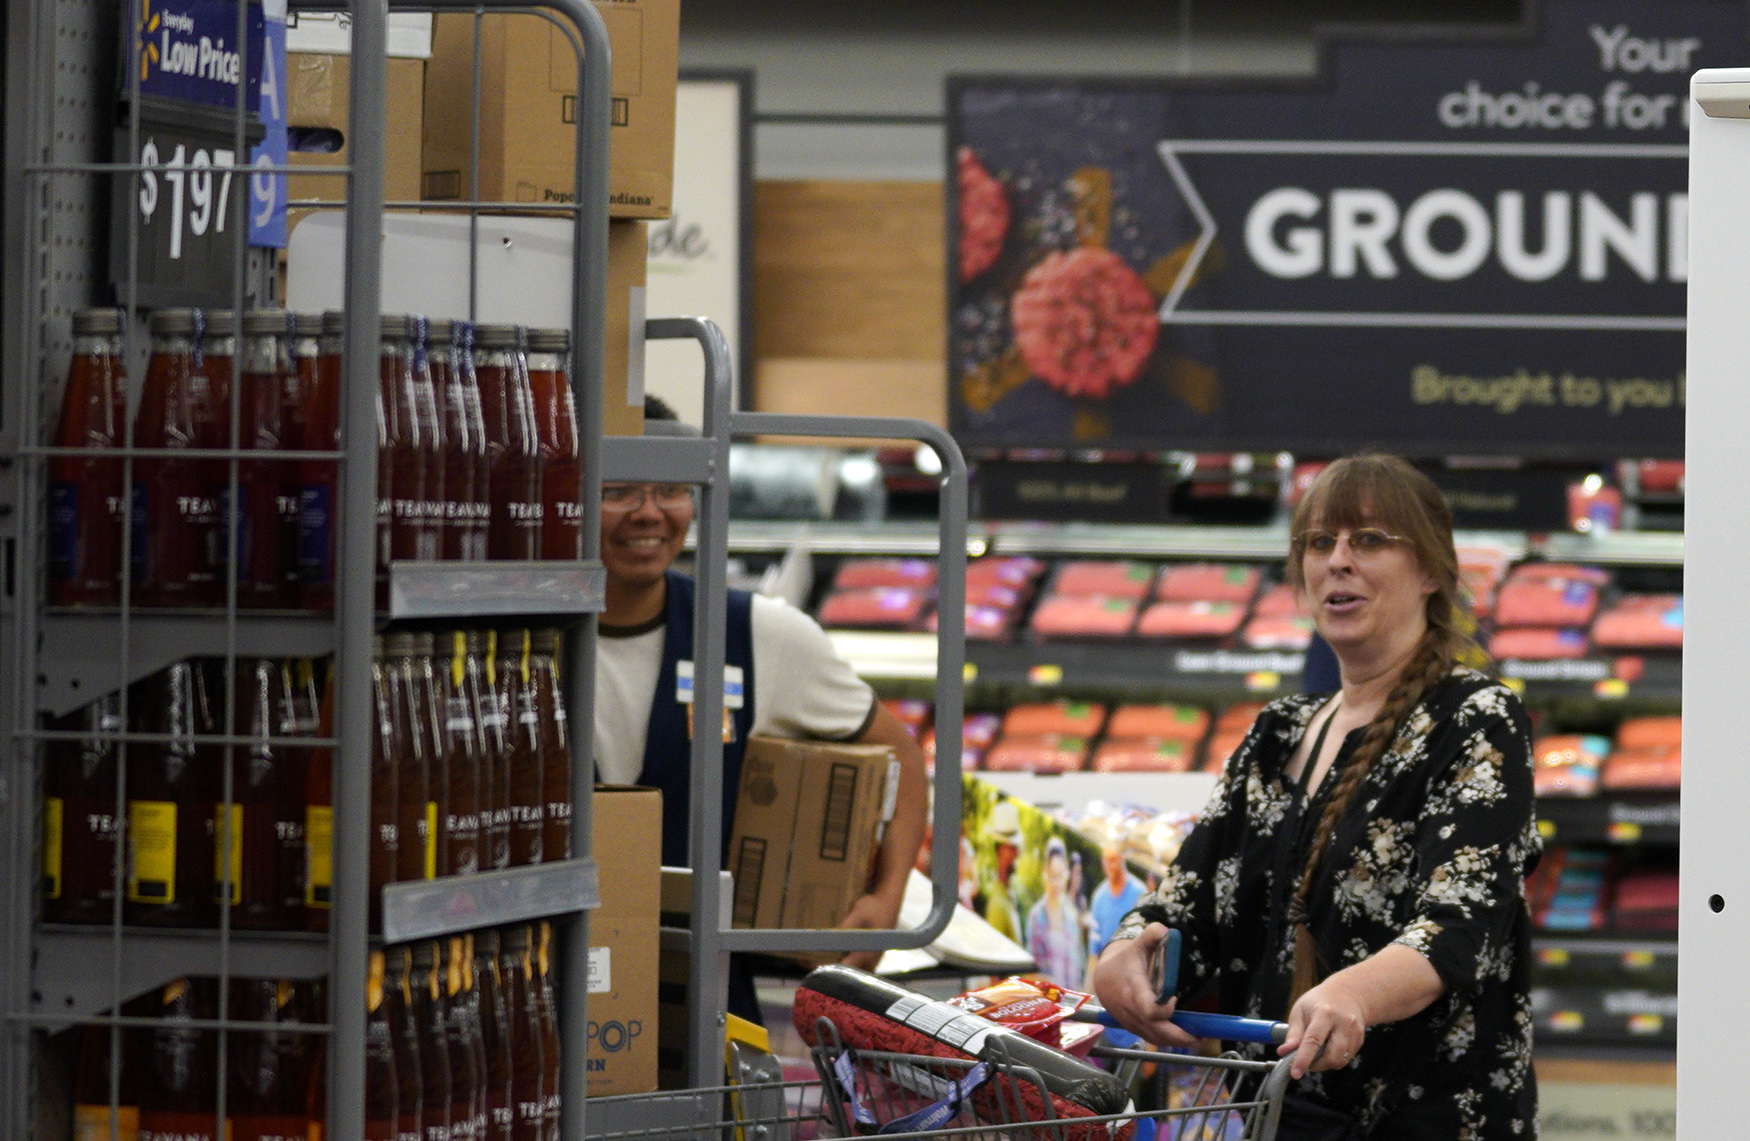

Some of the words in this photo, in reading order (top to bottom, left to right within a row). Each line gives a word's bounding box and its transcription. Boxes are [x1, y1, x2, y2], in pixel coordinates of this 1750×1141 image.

[161, 28, 198, 76] Low
[198, 36, 240, 85] Price
[1589, 24, 1700, 73] Your
[1438, 79, 1596, 130] choice
[1602, 79, 1676, 131] for
[1411, 365, 1552, 413] Brought
[1561, 373, 1602, 405] to
[1609, 377, 1673, 409] you
